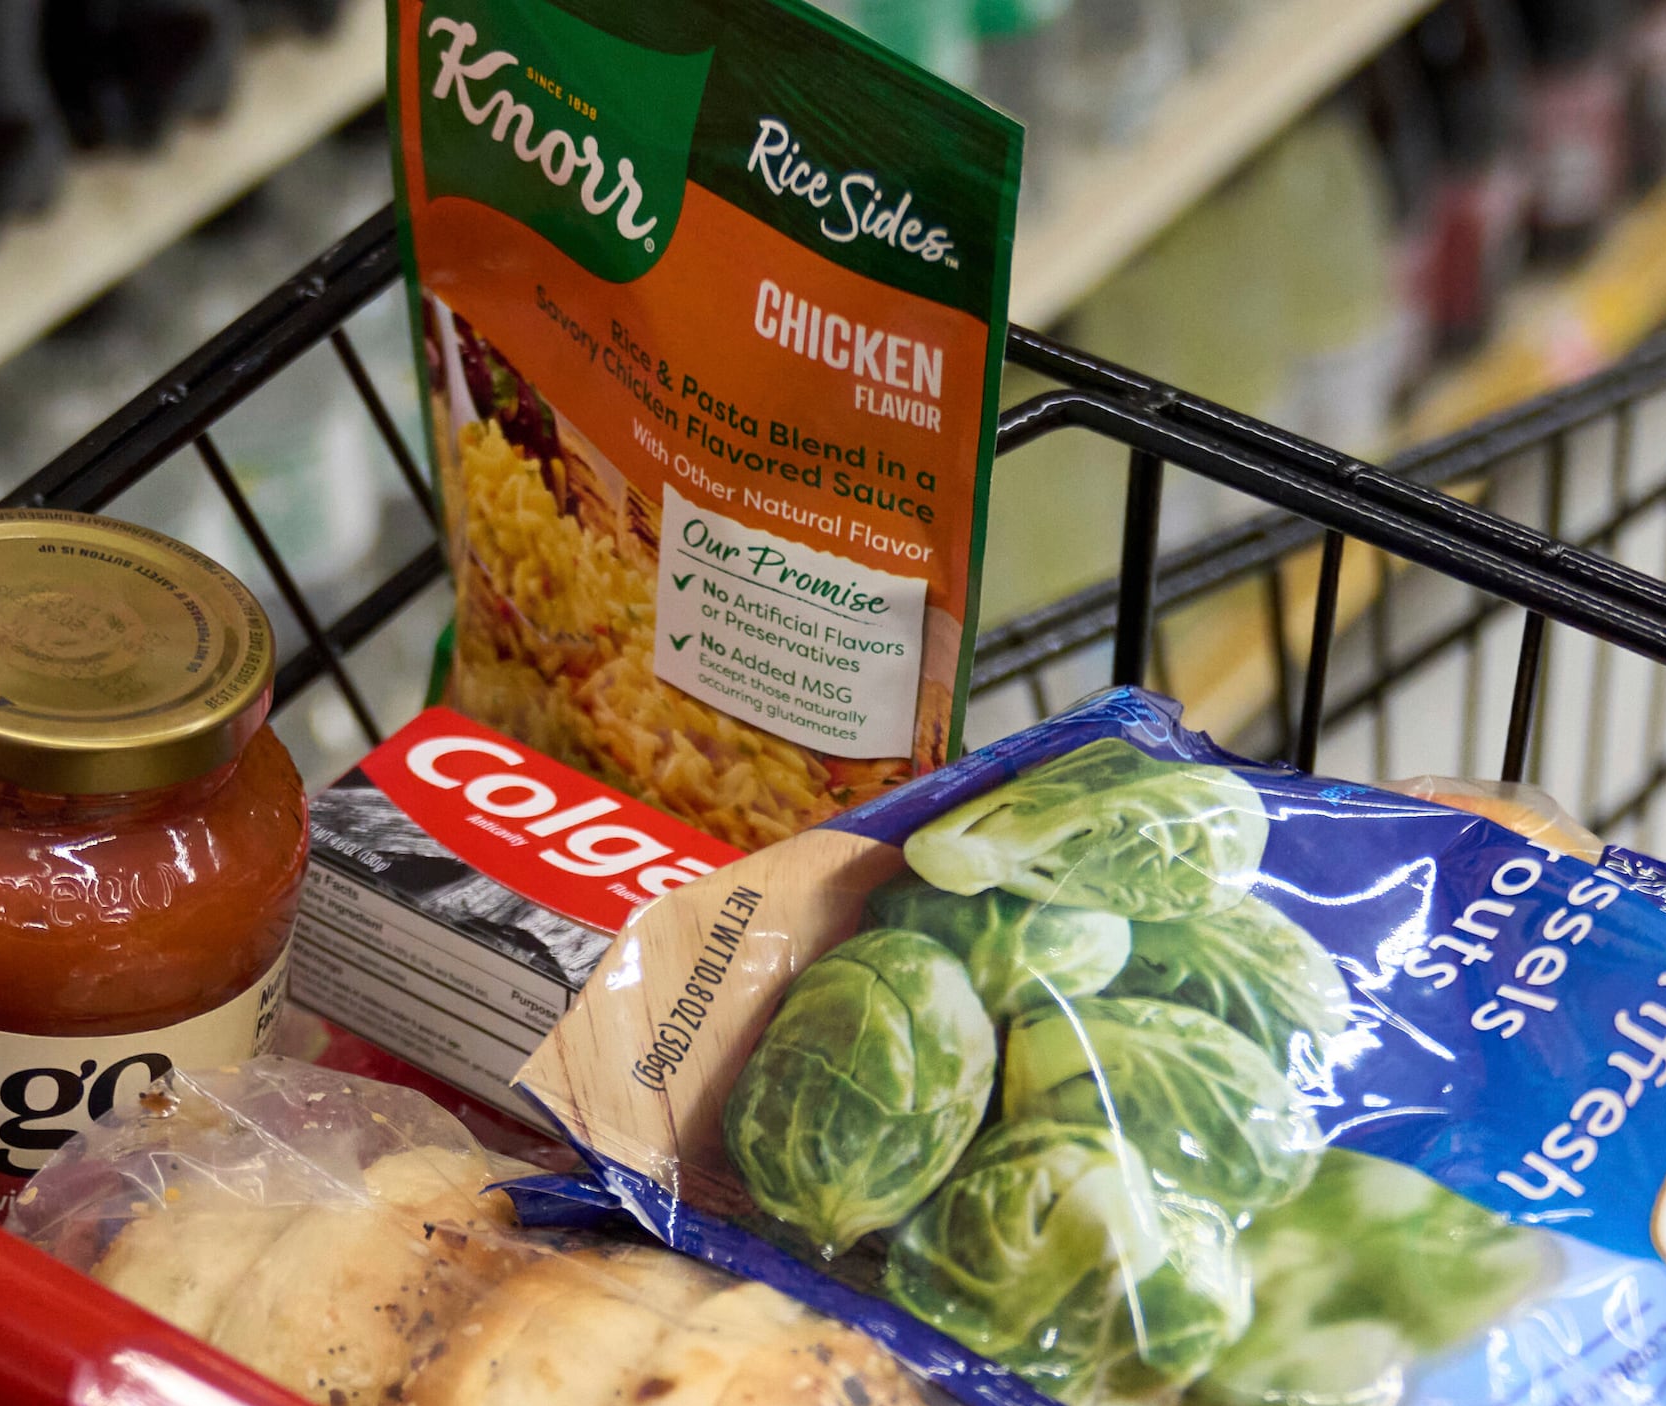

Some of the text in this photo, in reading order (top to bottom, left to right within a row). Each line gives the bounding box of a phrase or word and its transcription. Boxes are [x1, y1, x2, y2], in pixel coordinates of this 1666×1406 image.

[427, 15, 658, 242] Knorr
[524, 65, 599, 122] SINCE 1838
[746, 116, 954, 264] Rice Sides
[753, 278, 944, 400] CHICKEN
[534, 284, 936, 525] Savory Chicken Flavored Sauce
[610, 319, 937, 494] Rice & Pasta Blend in a
[853, 383, 942, 434] FLAVOR
[632, 417, 934, 563] With Other Natural Flavor
[37, 544, 57, 556] UP
[60, 544, 77, 556] IS
[79, 547, 133, 569] BUTTON
[133, 565, 179, 591] SAFETY
[683, 518, 891, 616] Our Promise
[701, 603, 861, 674] or Preservatives
[702, 578, 906, 657] No Artificial Flavors
[698, 652, 869, 727] Except those naturally
[700, 631, 854, 705] No Added MSG
[697, 671, 858, 742] occurring glutamates
[356, 846, 393, 874] (130g)
[464, 812, 531, 848] Anticavity
[323, 873, 360, 901] Facts
[632, 885, 764, 1093] NET WT 10.8 OZ (306g)
[1470, 866, 1623, 1041] ssels
[510, 988, 560, 1022] Purpose
